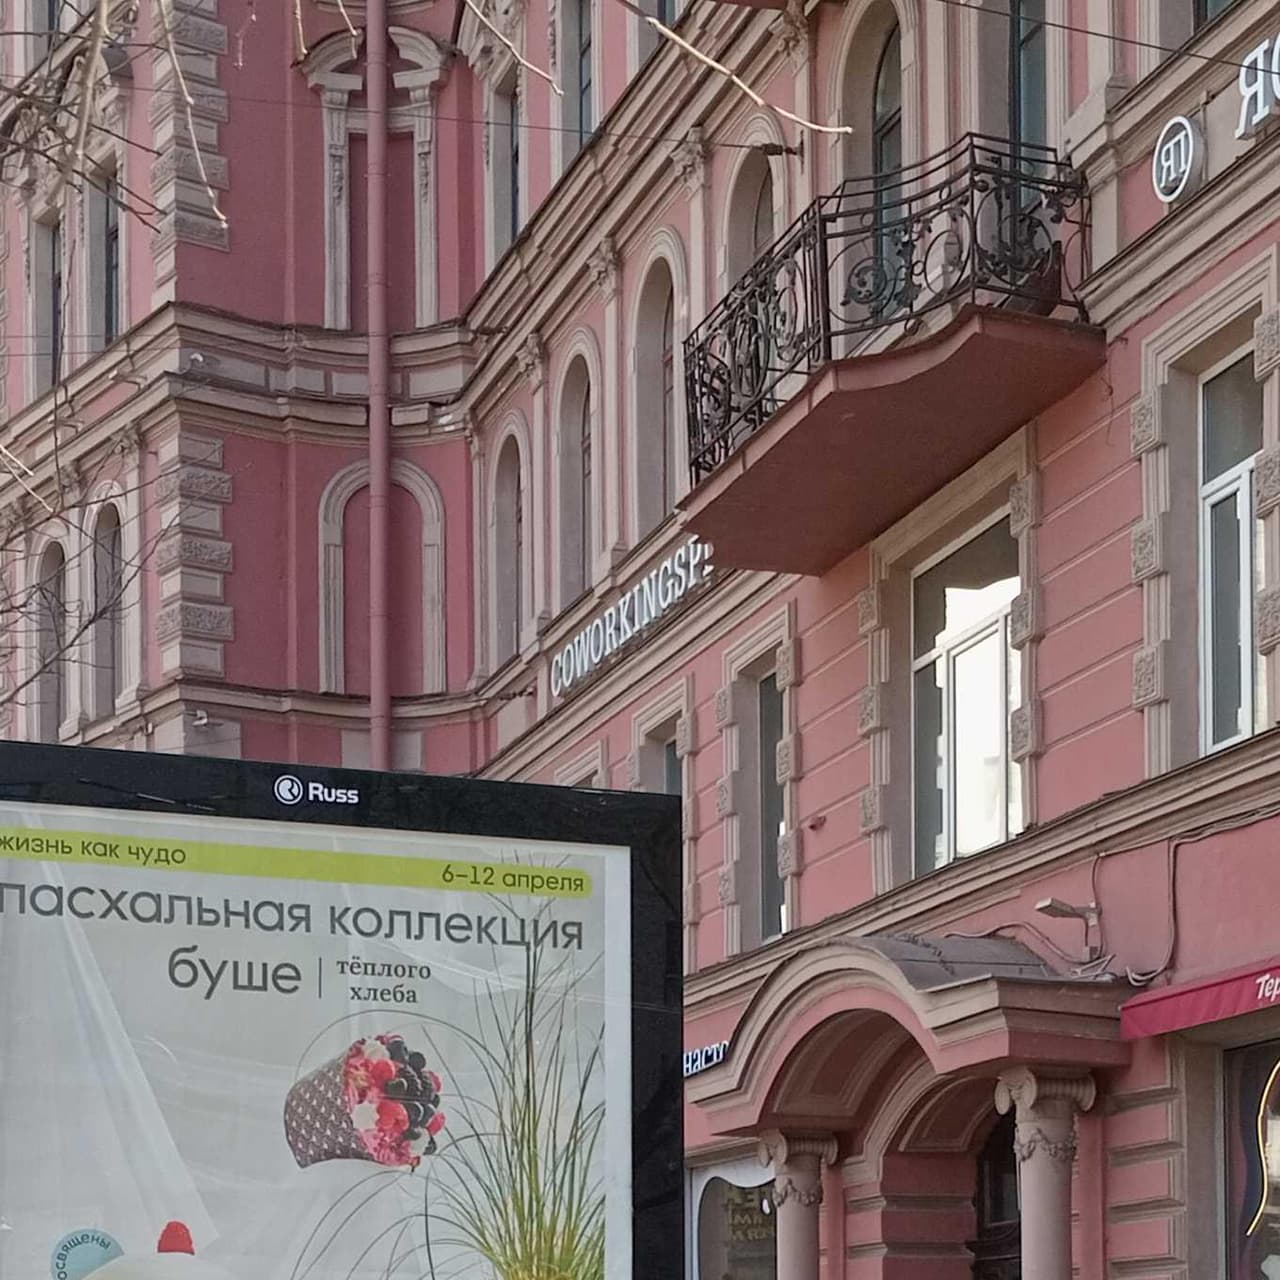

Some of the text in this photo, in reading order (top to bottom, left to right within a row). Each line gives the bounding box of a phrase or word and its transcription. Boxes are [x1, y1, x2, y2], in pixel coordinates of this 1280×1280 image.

[308, 782, 359, 804] Russ
[81, 839, 120, 858] как
[128, 845, 187, 866] чудо
[502, 872, 584, 893] апреля
[329, 905, 584, 950] коллекция
[167, 943, 303, 999] буше
[336, 956, 432, 980] тёплого
[349, 985, 418, 1004] хлеба
[55, 1233, 112, 1280] освящены
